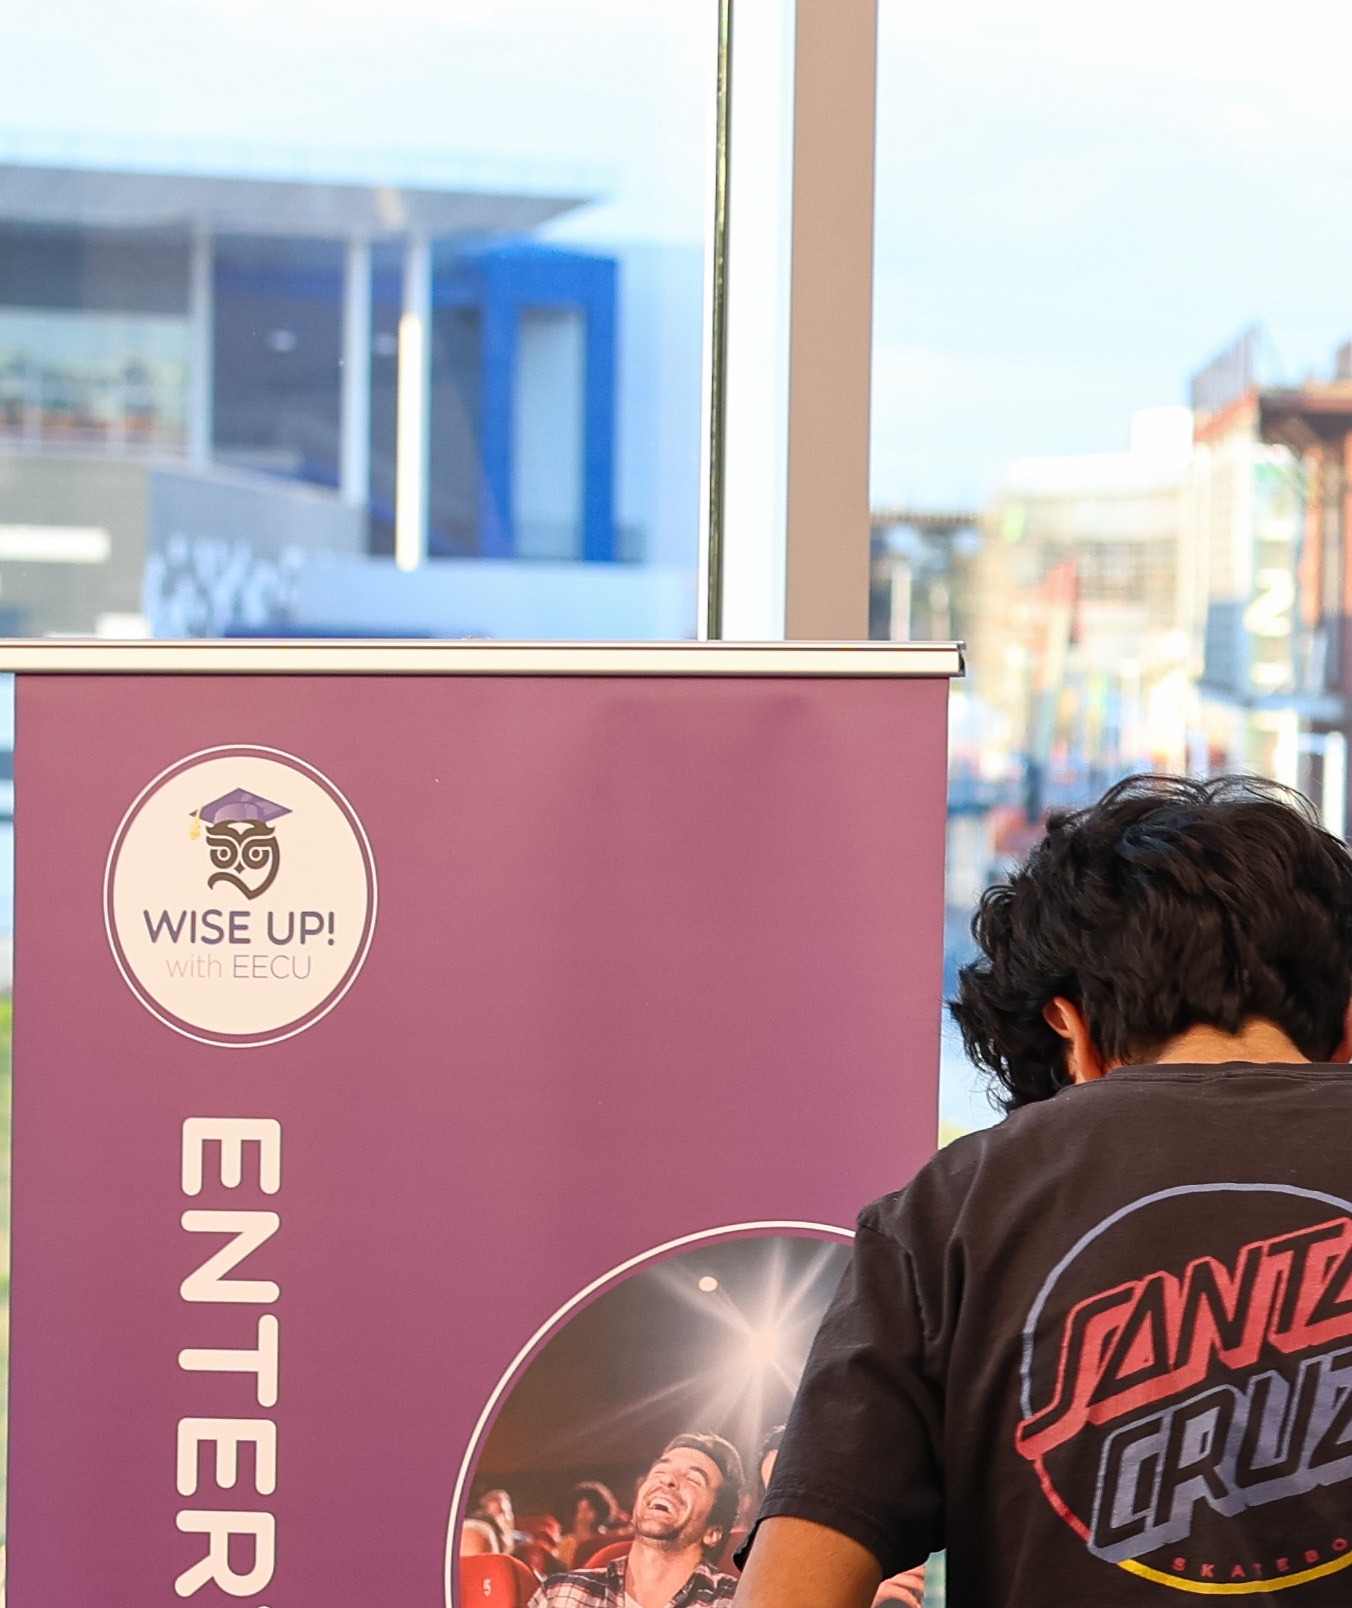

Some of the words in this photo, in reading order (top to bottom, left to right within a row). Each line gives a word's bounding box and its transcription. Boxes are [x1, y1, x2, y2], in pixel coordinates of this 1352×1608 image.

[144, 909, 251, 945] WISE
[267, 911, 335, 946] UP!
[165, 954, 222, 978] with
[233, 955, 311, 979] EECU
[483, 1578, 491, 1597] 5
